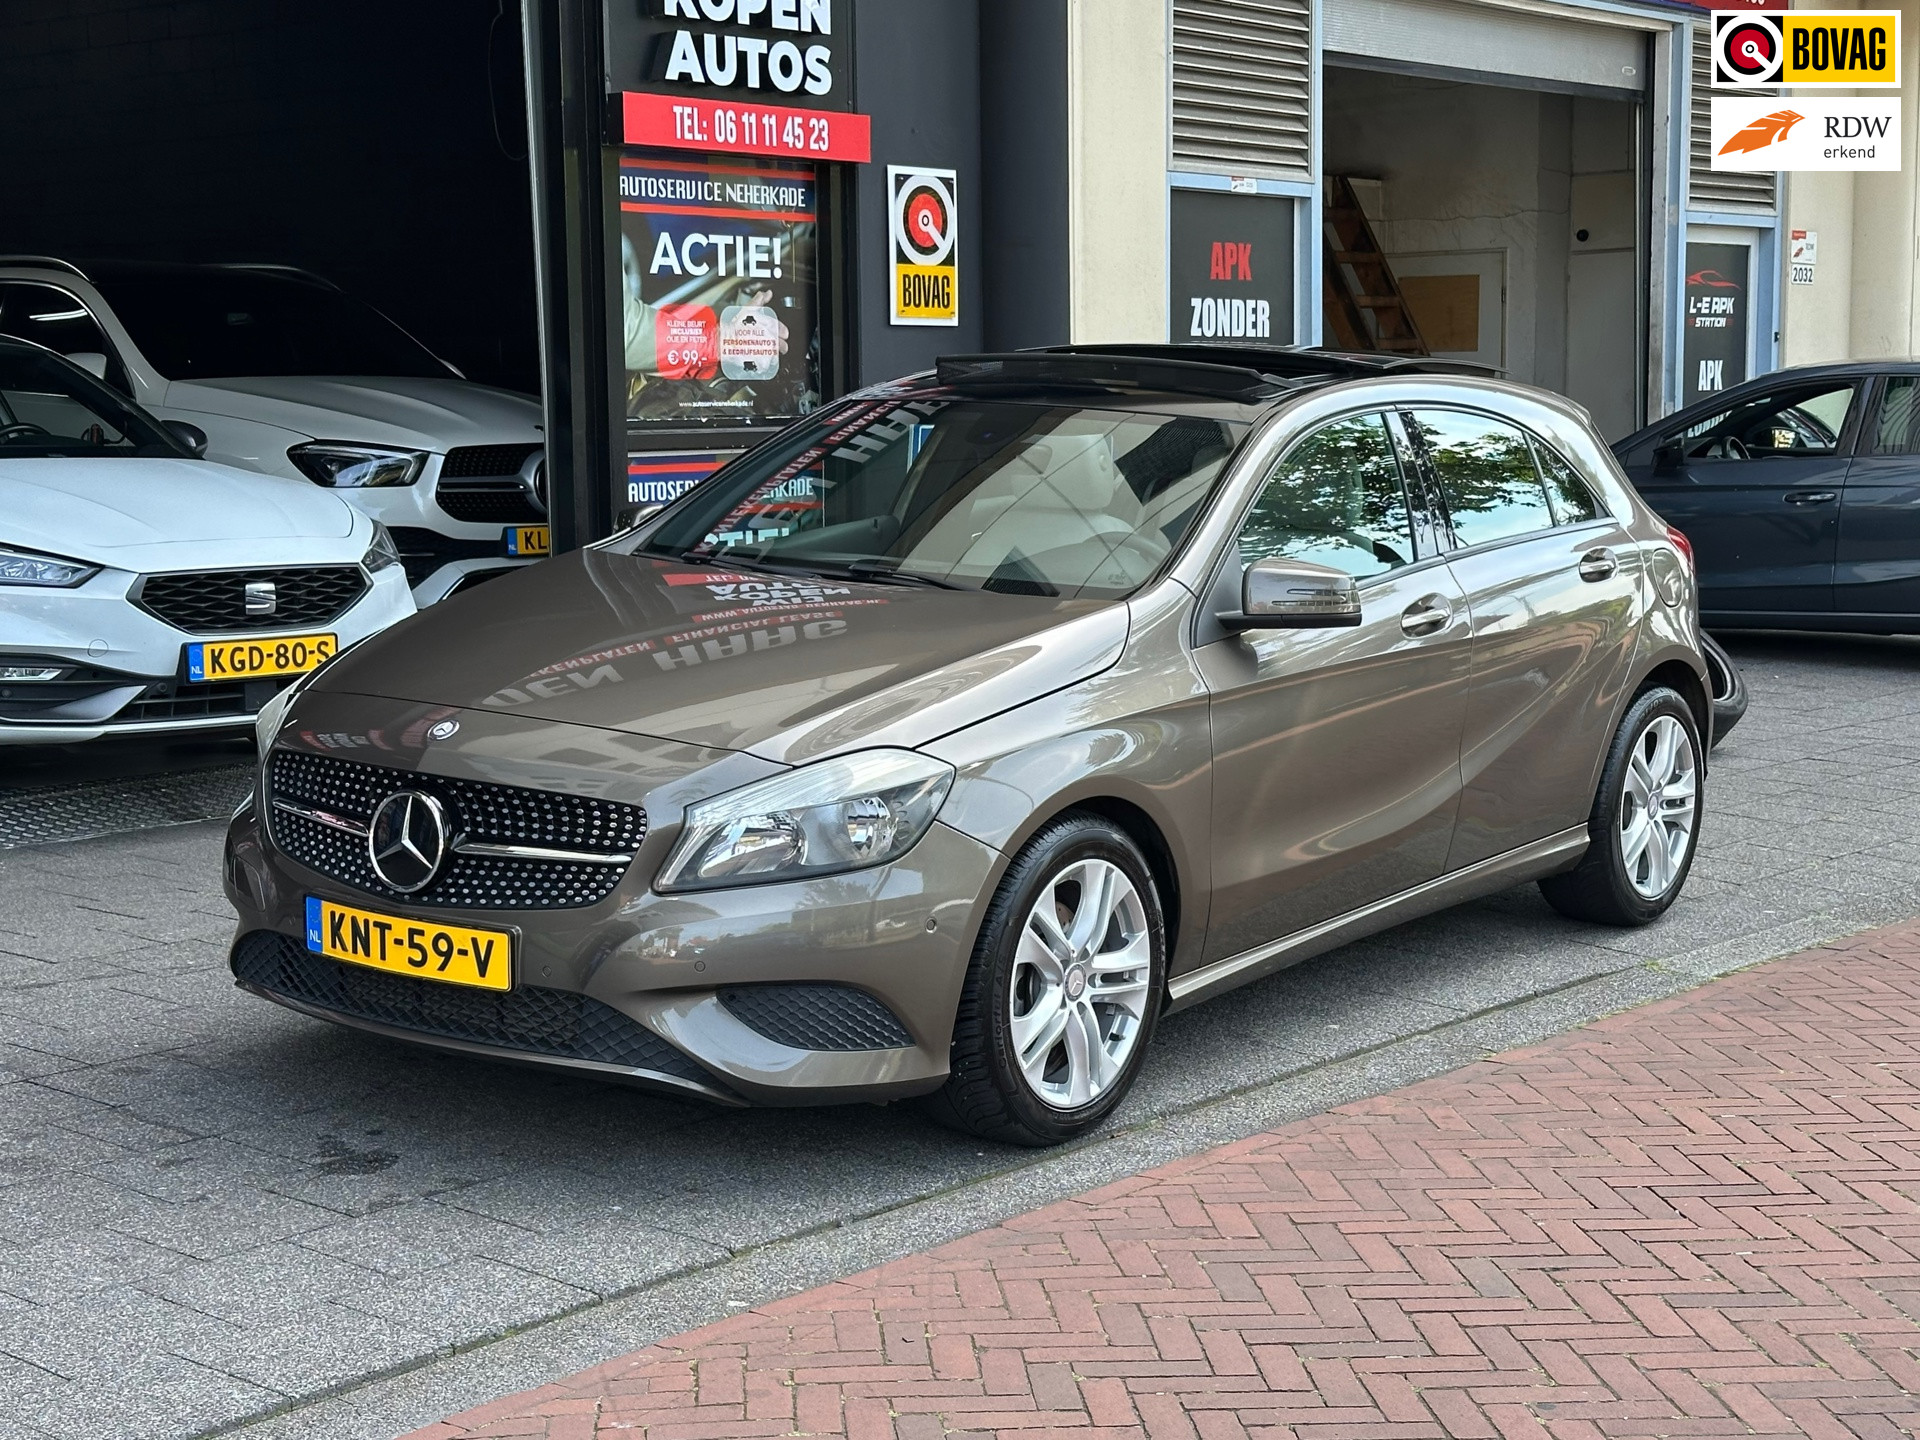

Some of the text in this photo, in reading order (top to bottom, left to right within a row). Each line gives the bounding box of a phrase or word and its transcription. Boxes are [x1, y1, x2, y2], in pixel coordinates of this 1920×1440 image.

[664, 30, 832, 95] AUTOS
[673, 105, 829, 152] TEL: 06 11 11 45 23
[620, 175, 806, 208] AUTOSERVICE NEHERKADE
[650, 231, 783, 280] ACTIE!
[1210, 242, 1252, 281] APK
[903, 274, 950, 310] BOVAG
[1793, 267, 1813, 283] 2032
[1190, 298, 1270, 338] ZONDER
[1689, 297, 1735, 314] L-E APK
[1695, 317, 1726, 328] STATION
[723, 339, 776, 347] PERSONENAUTO'S
[734, 329, 764, 337] VOOR ALLE
[682, 350, 708, 367] 99,-
[1698, 360, 1723, 391] APK
[191, 640, 330, 675] NL KGD-80-S
[309, 910, 494, 977] NL KNT-59-V
